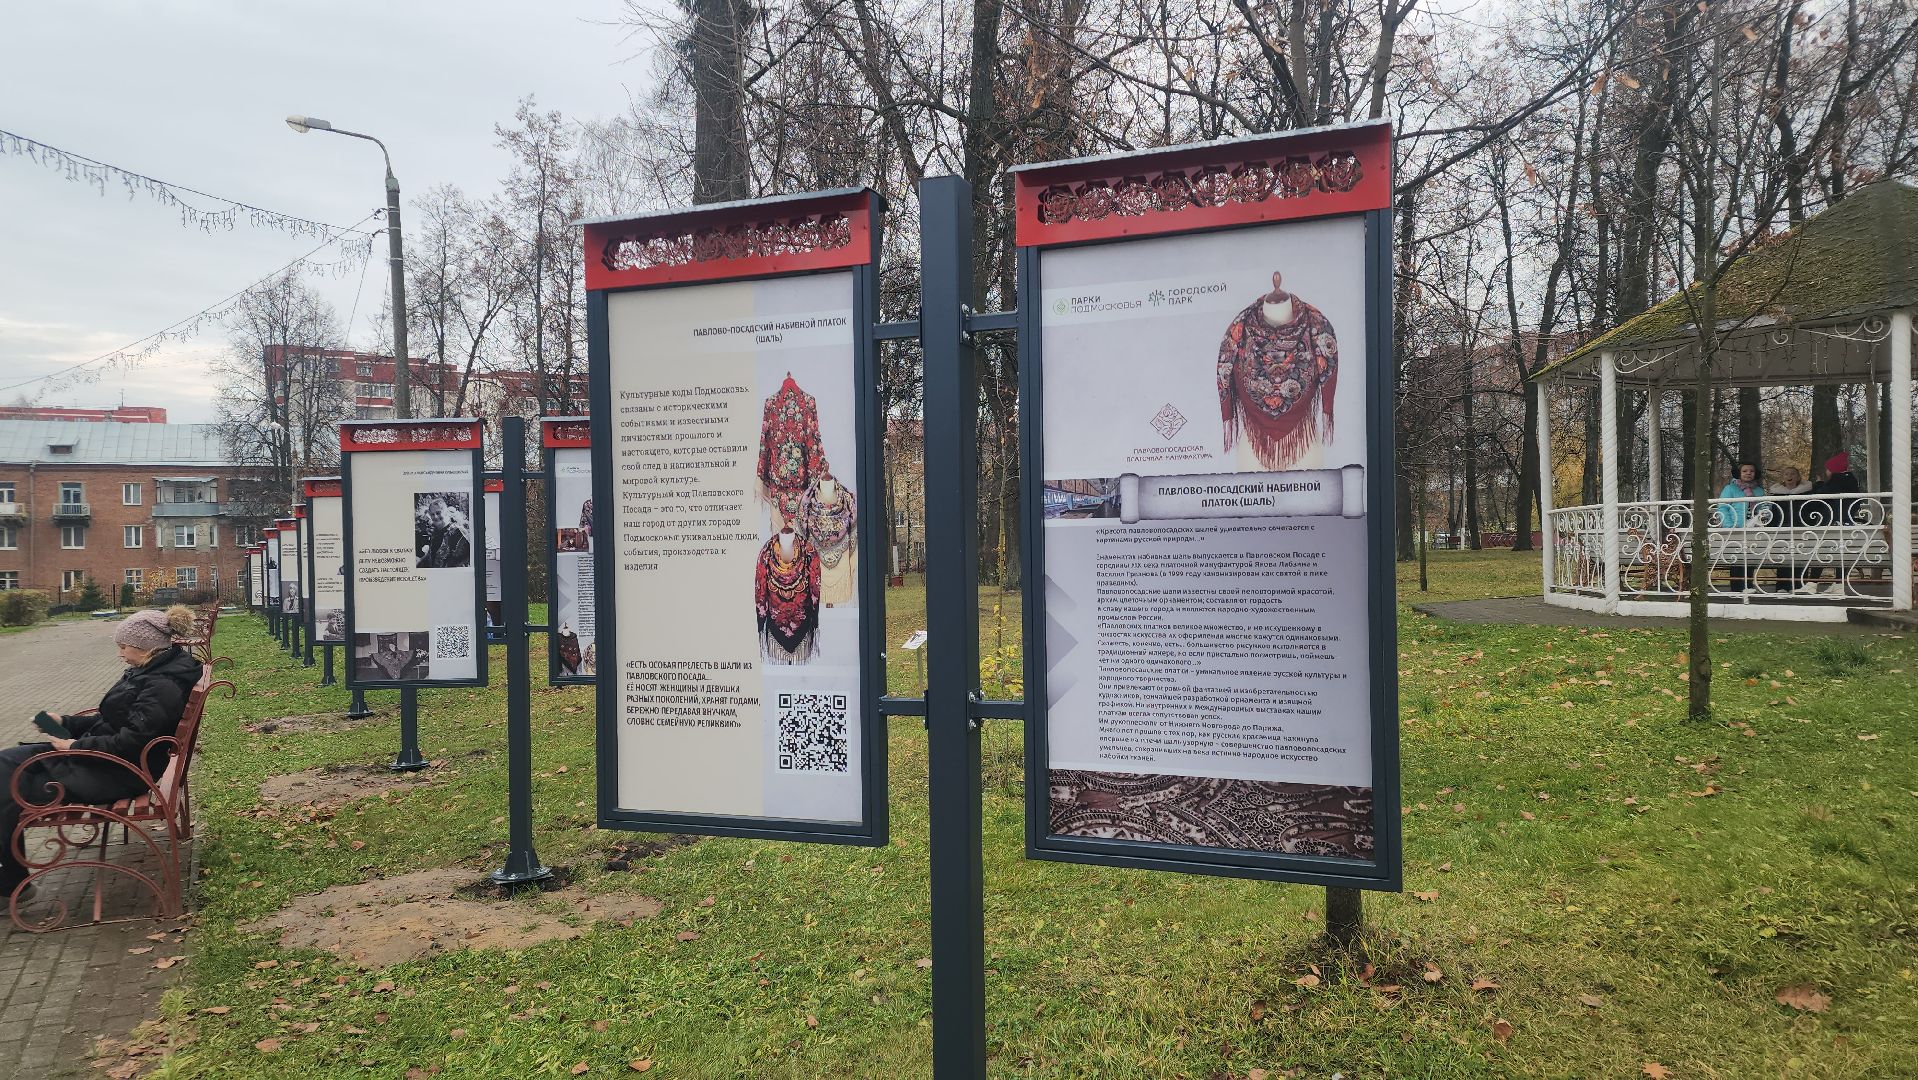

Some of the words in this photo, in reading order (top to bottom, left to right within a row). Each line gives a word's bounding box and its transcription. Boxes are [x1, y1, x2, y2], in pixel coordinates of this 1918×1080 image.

[1169, 284, 1227, 296] ГОРОДСКОЙ
[1072, 296, 1100, 304] ПАРКИ
[1169, 296, 1192, 305] ПАРК
[1072, 301, 1142, 313] ПОДМОСКОВЬЯ
[694, 322, 773, 336] ПАВЛОВО-ПОСАДСКИЙ
[776, 318, 815, 330] НАБИВНОЙ
[756, 334, 782, 344] (ШАЛЬ)
[621, 390, 669, 400] Культурные
[664, 402, 728, 411] историческими
[675, 432, 714, 441] прошлого
[674, 448, 706, 456] которые
[622, 462, 640, 470] свой
[643, 462, 661, 470] след
[670, 459, 729, 469] национальной
[622, 476, 658, 486] мировой
[1158, 483, 1264, 495] ПАВЛОВО-ПОСАДСКИЙ
[1267, 481, 1320, 493] НАБИВНОЙ
[1202, 498, 1238, 507] ПЛАТОК
[1240, 497, 1275, 507] (ШАЛЬ)
[623, 506, 651, 514] Посада
[678, 519, 706, 528] других
[624, 548, 660, 556] события,
[625, 563, 658, 571] изделия
[649, 661, 676, 669] ОСОБАЯ
[660, 684, 698, 692] ЖЕНЩИНЫ
[706, 685, 739, 694] ДЕВУШКИ
[702, 696, 727, 704] ХРАНЯТ
[626, 706, 659, 714] БЕРЕЖНО
[662, 708, 700, 716] ПЕРЕДАВАЯ
[657, 717, 695, 726] СЕМЕЙНУЮ
